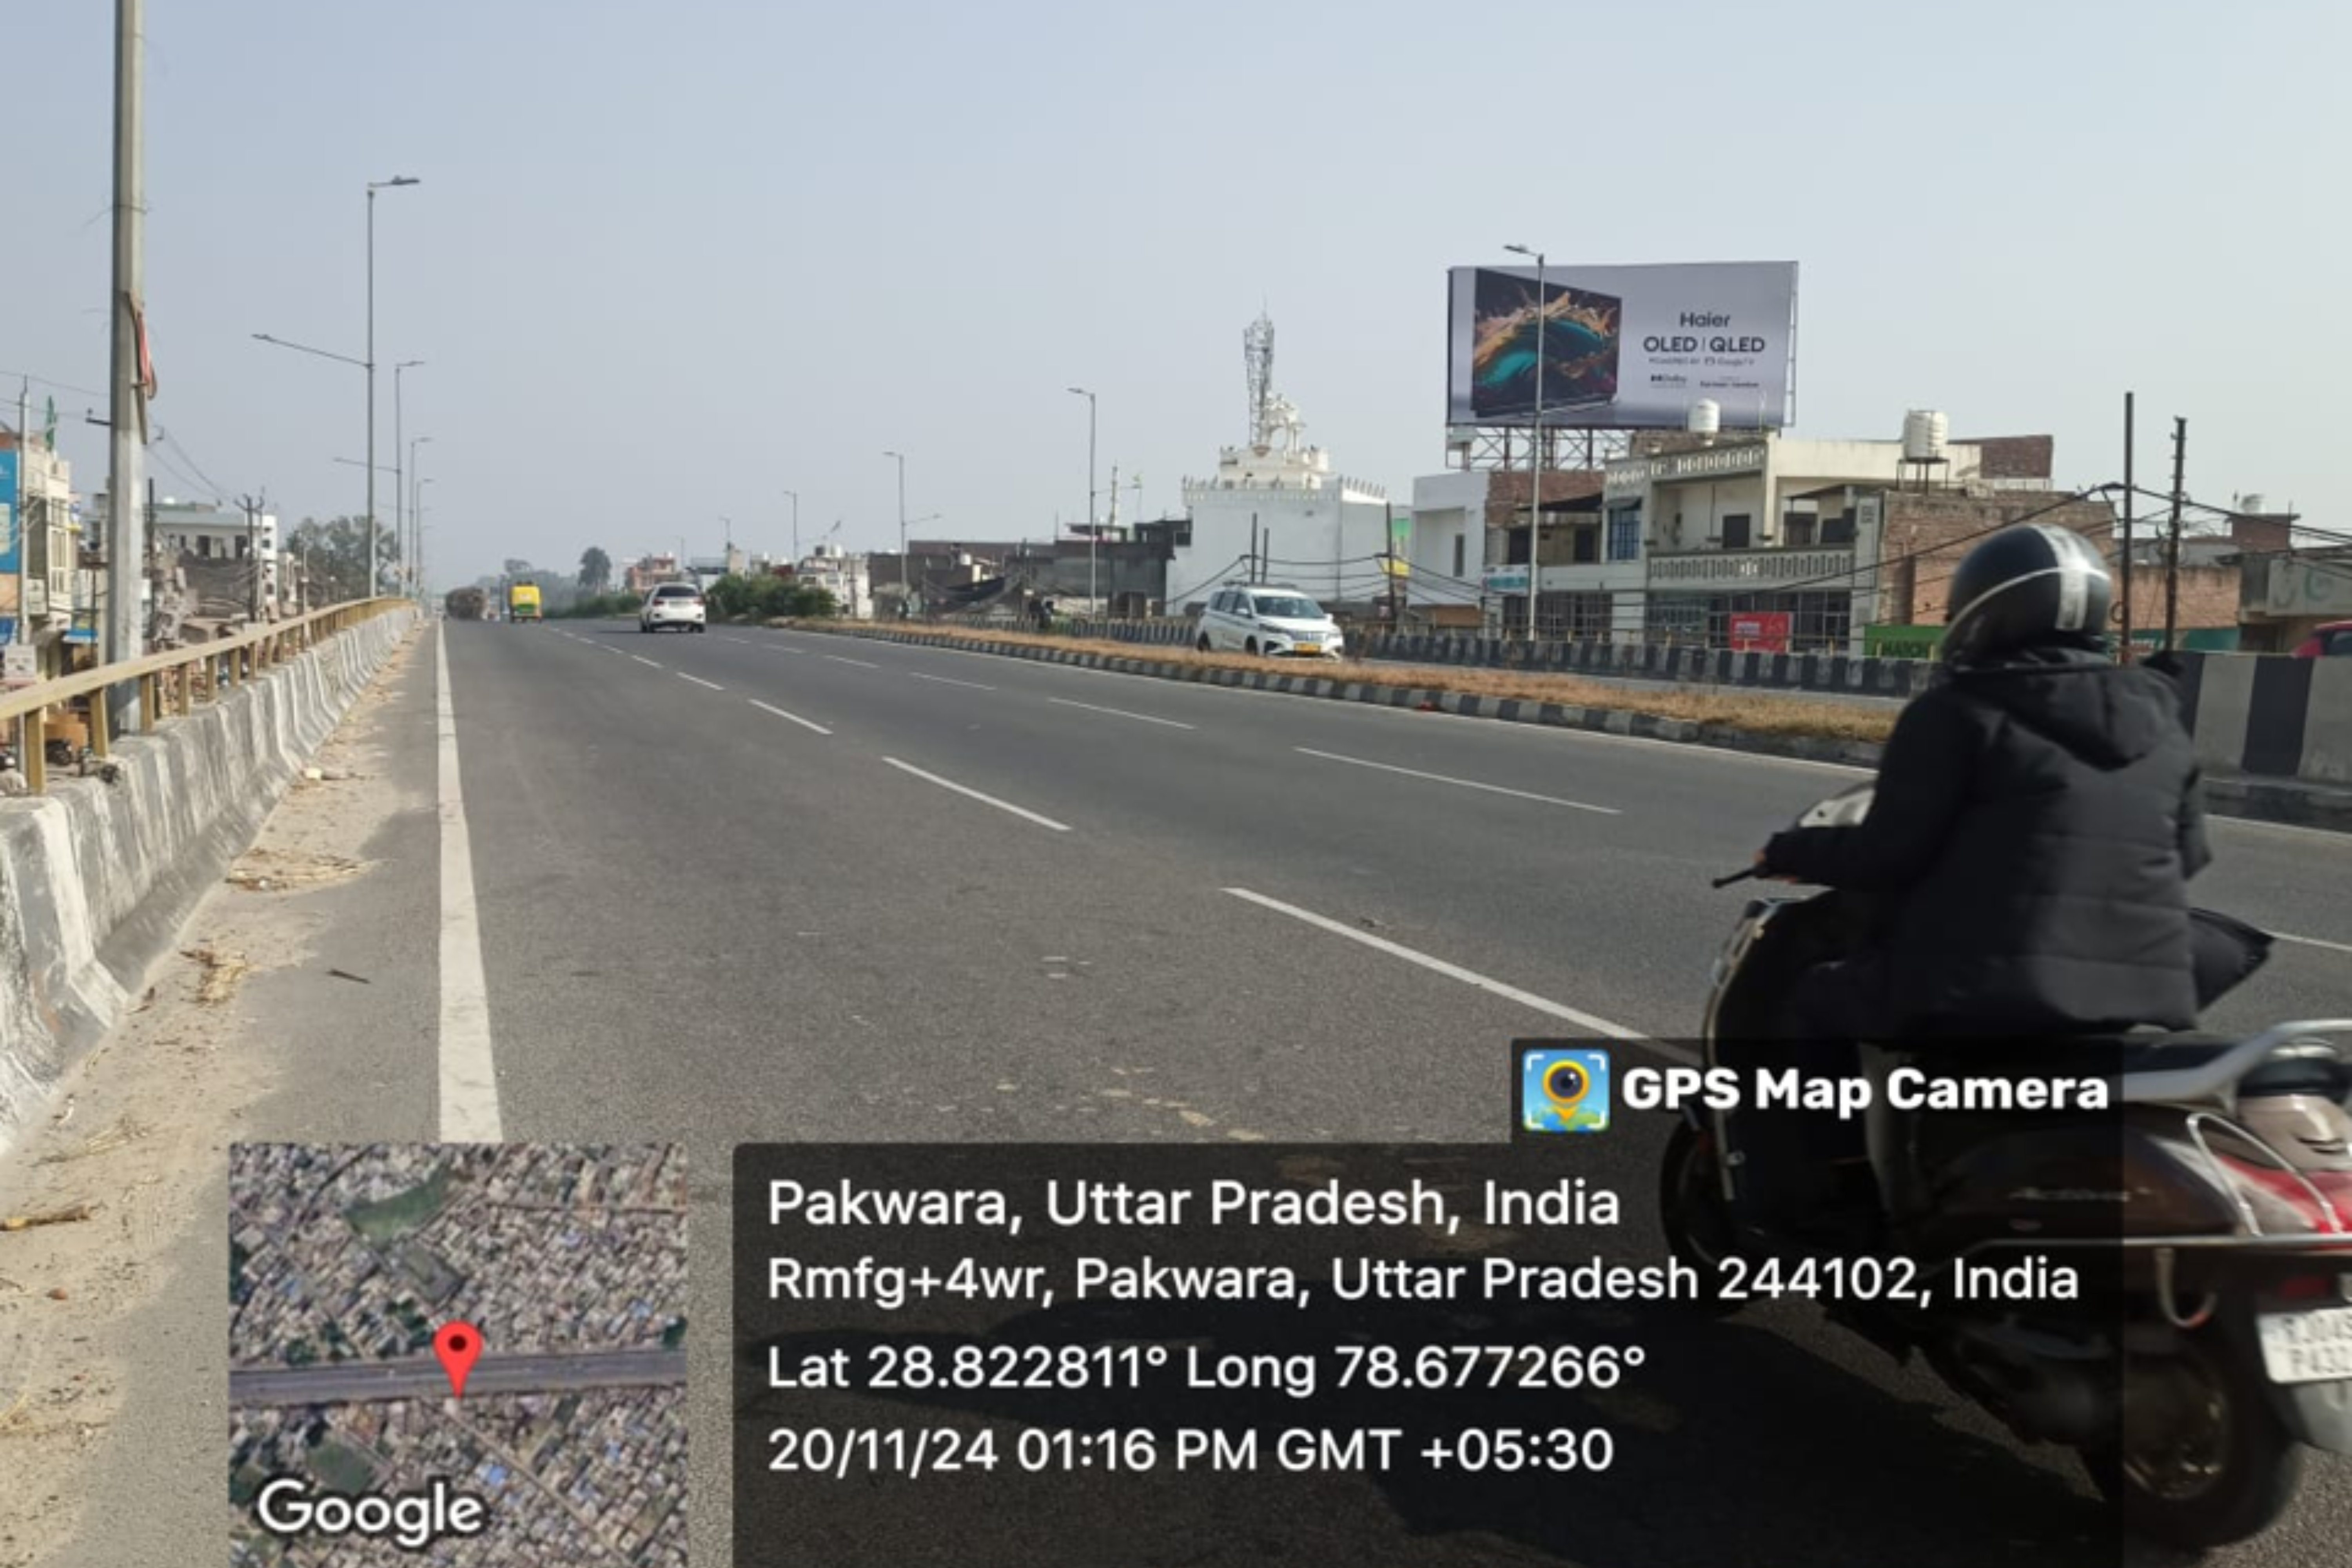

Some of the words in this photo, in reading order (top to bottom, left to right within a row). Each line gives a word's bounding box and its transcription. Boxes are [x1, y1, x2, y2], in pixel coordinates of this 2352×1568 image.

[1680, 312, 1730, 328] Haier
[1643, 336, 1698, 352] OLED
[1709, 336, 1765, 352] QLED
